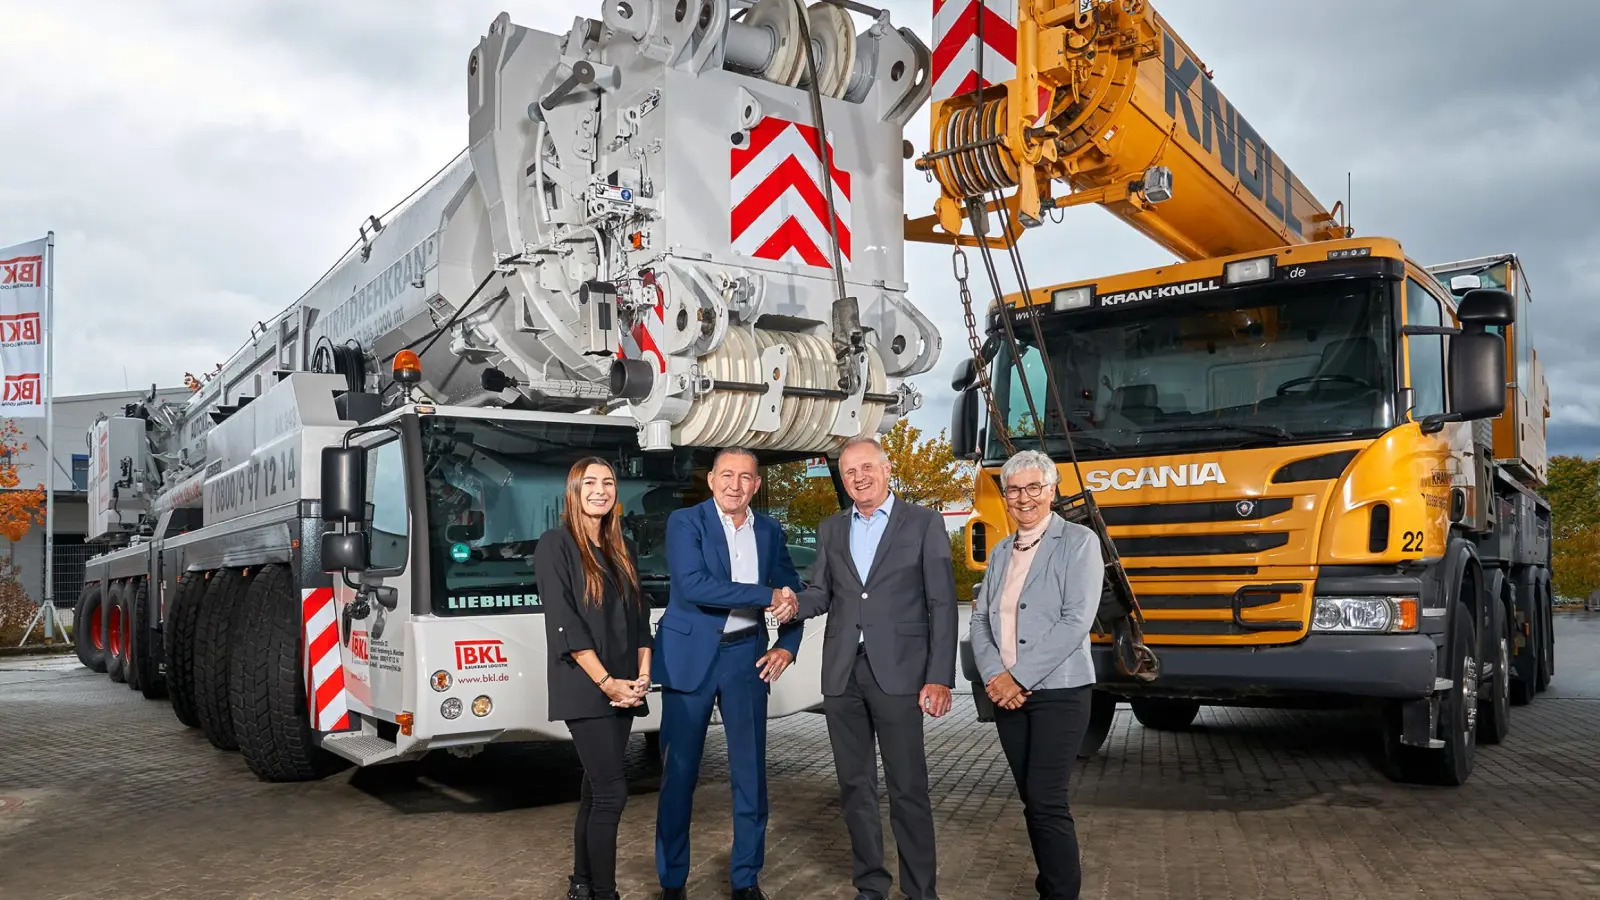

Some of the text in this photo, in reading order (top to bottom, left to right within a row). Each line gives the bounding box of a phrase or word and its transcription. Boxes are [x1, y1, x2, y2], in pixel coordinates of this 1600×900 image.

[1164, 30, 1302, 236] KNOLL
[1101, 280, 1220, 306] KRAN-KNOLL
[264, 455, 277, 497] 12
[281, 447, 296, 492] 14
[1085, 462, 1227, 492] SCANIA
[1401, 530, 1424, 552] 22
[355, 637, 369, 660] BKL
[463, 645, 508, 665] BKL
[457, 673, 510, 684] www.bkl.de
